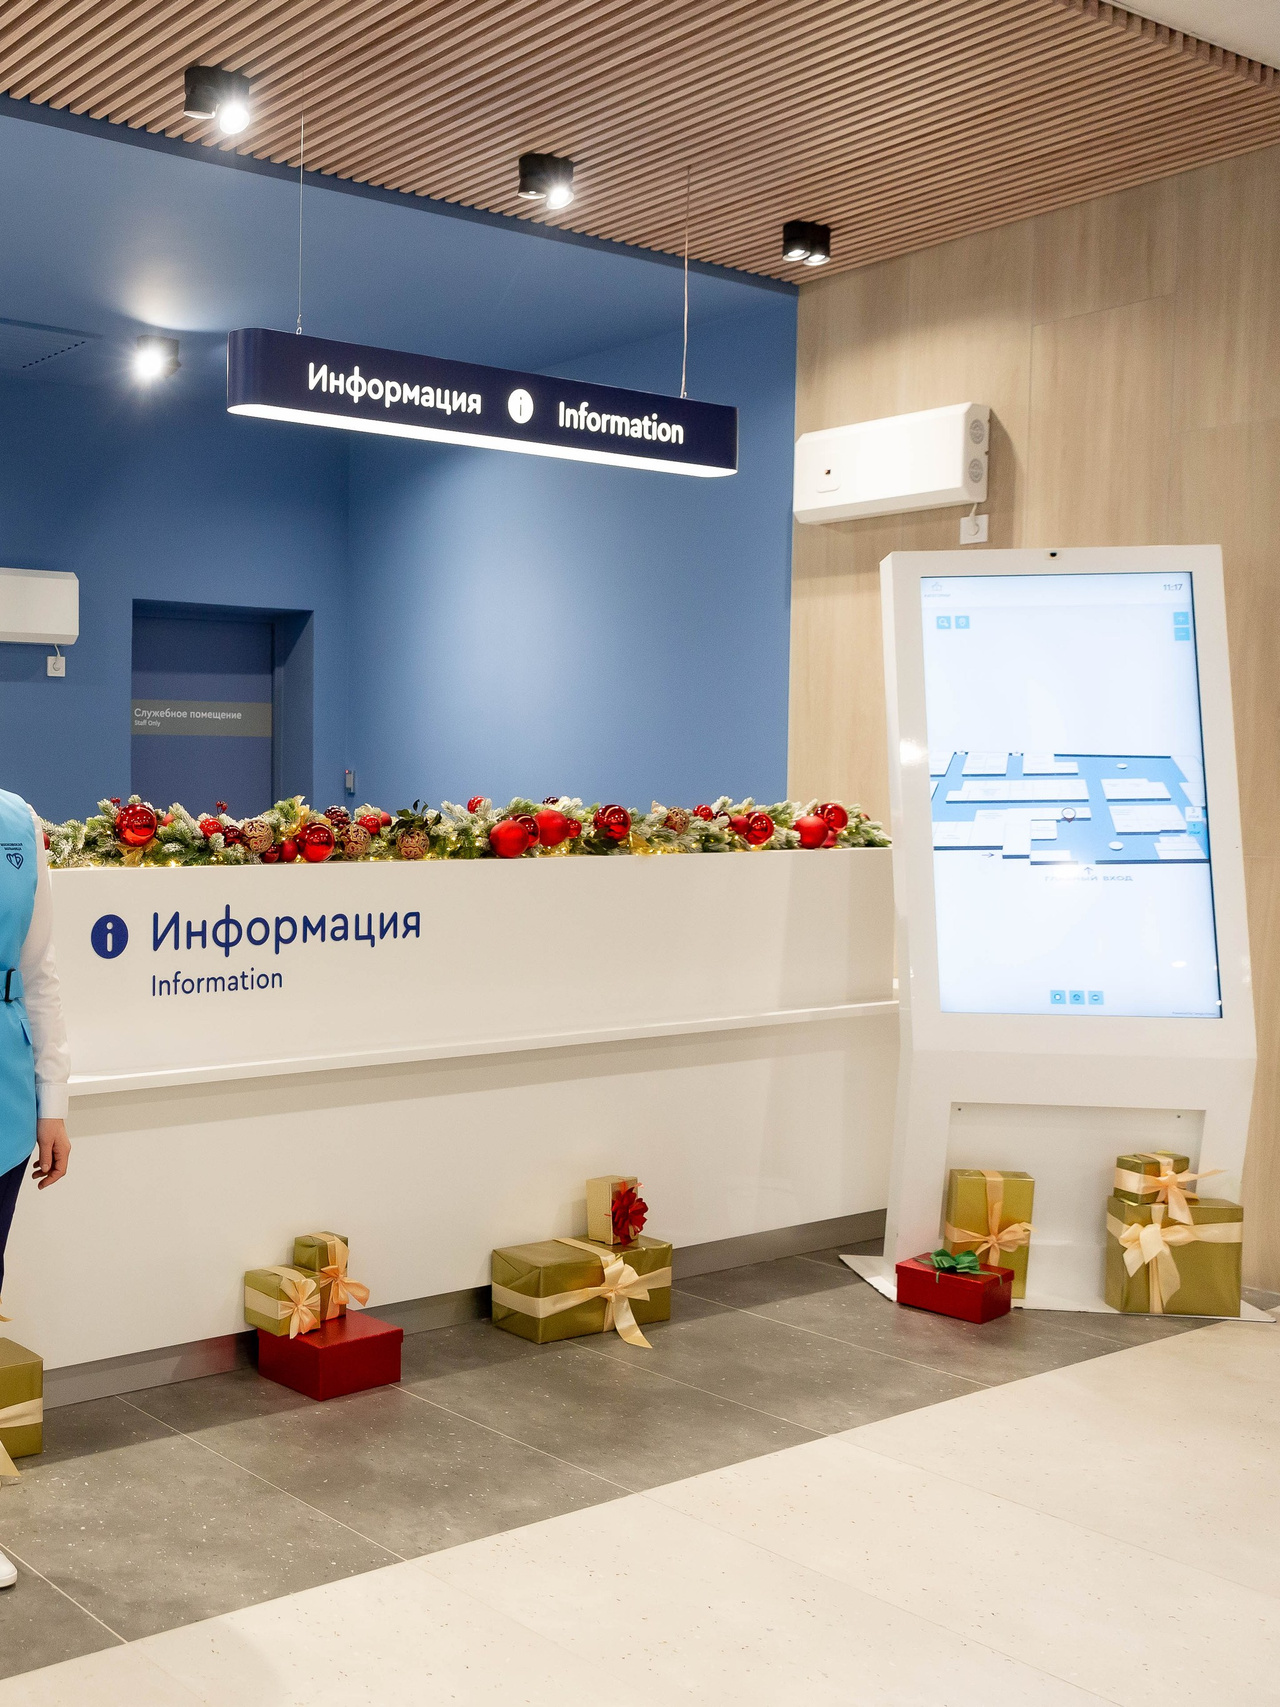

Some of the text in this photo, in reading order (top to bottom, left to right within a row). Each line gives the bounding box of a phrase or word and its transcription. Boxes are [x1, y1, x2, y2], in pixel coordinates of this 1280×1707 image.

[308, 362, 684, 445] Информация Information
[1163, 583, 1183, 591] 11:17
[134, 707, 242, 720] Служебное помещение
[147, 720, 161, 728] Only
[152, 904, 421, 957] Информация
[152, 967, 283, 997] Information
